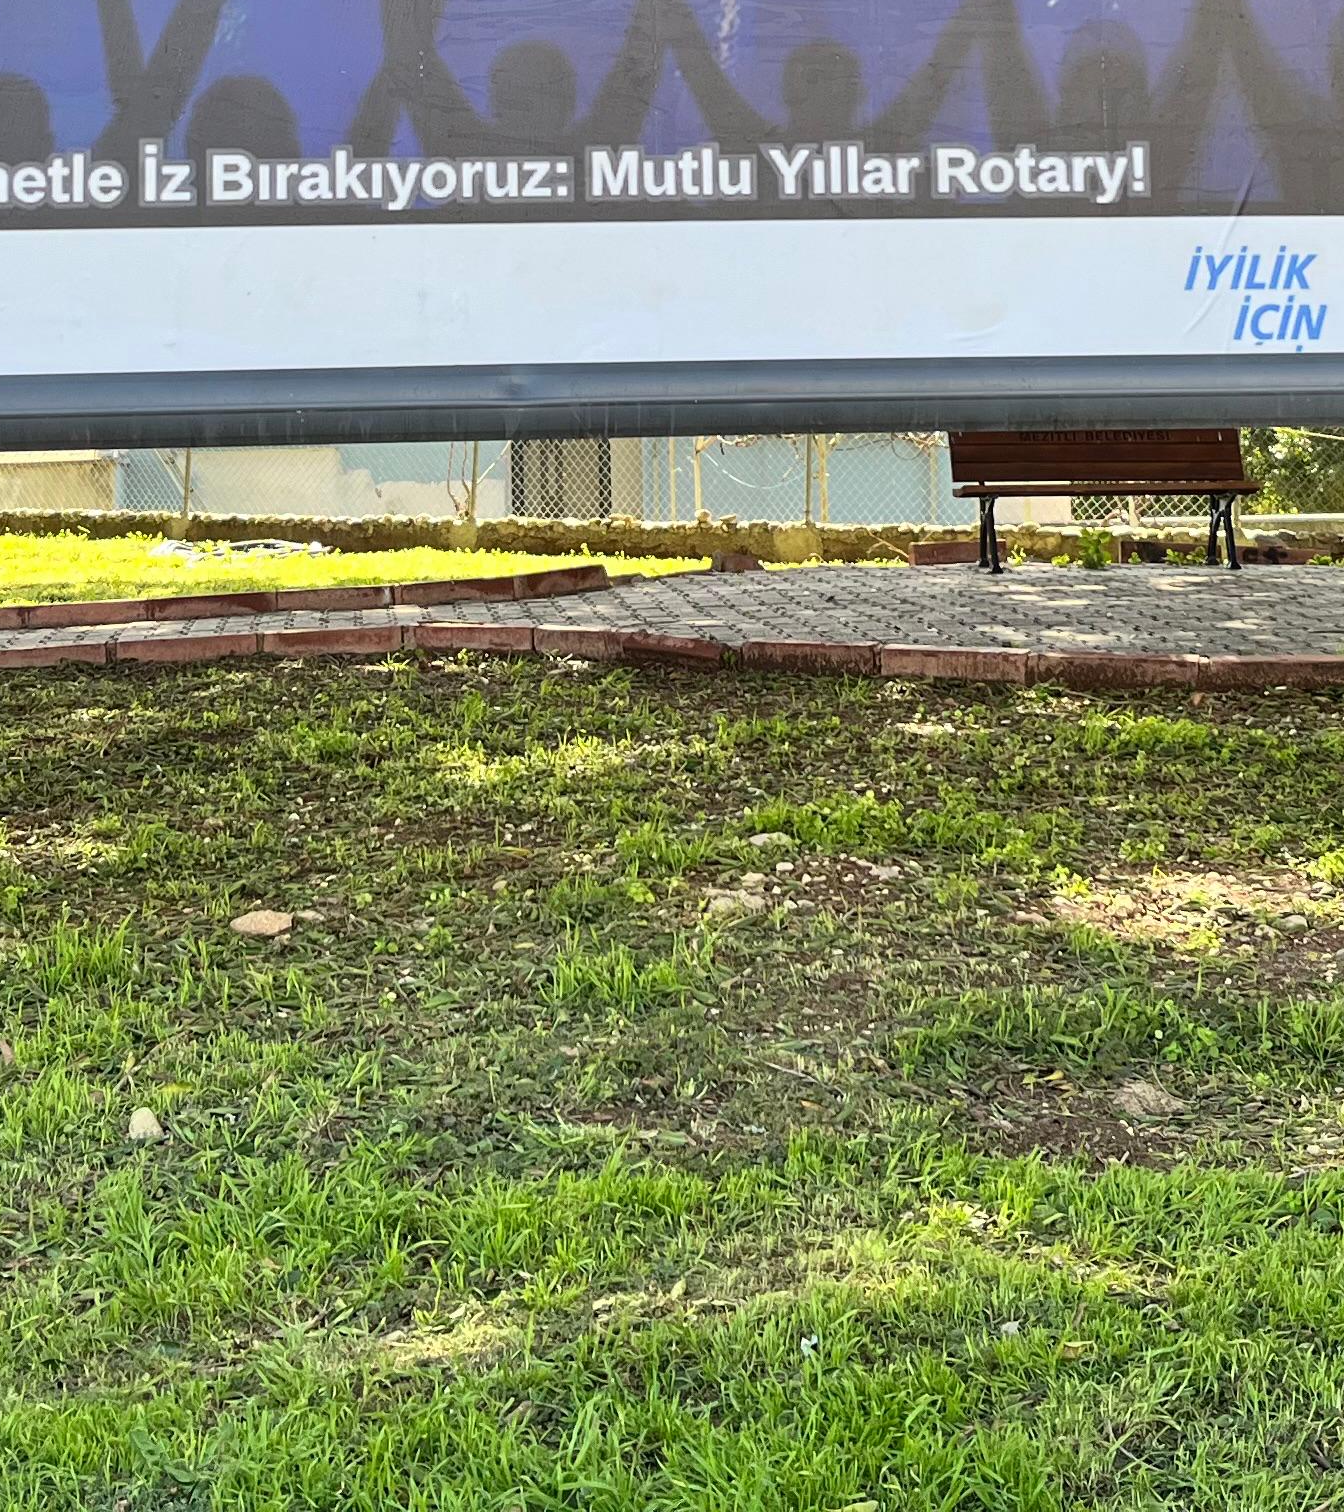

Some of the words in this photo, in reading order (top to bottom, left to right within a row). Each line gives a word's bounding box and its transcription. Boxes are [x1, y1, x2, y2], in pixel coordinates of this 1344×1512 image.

[144, 144, 191, 202] İz
[212, 150, 568, 211] Bırakıyoruz:
[591, 147, 752, 197] Mutlu
[768, 145, 920, 195] Yıllar
[936, 146, 1145, 204] Rotary!
[1183, 245, 1318, 291] İYİLİK
[1232, 294, 1328, 346] İÇİN
